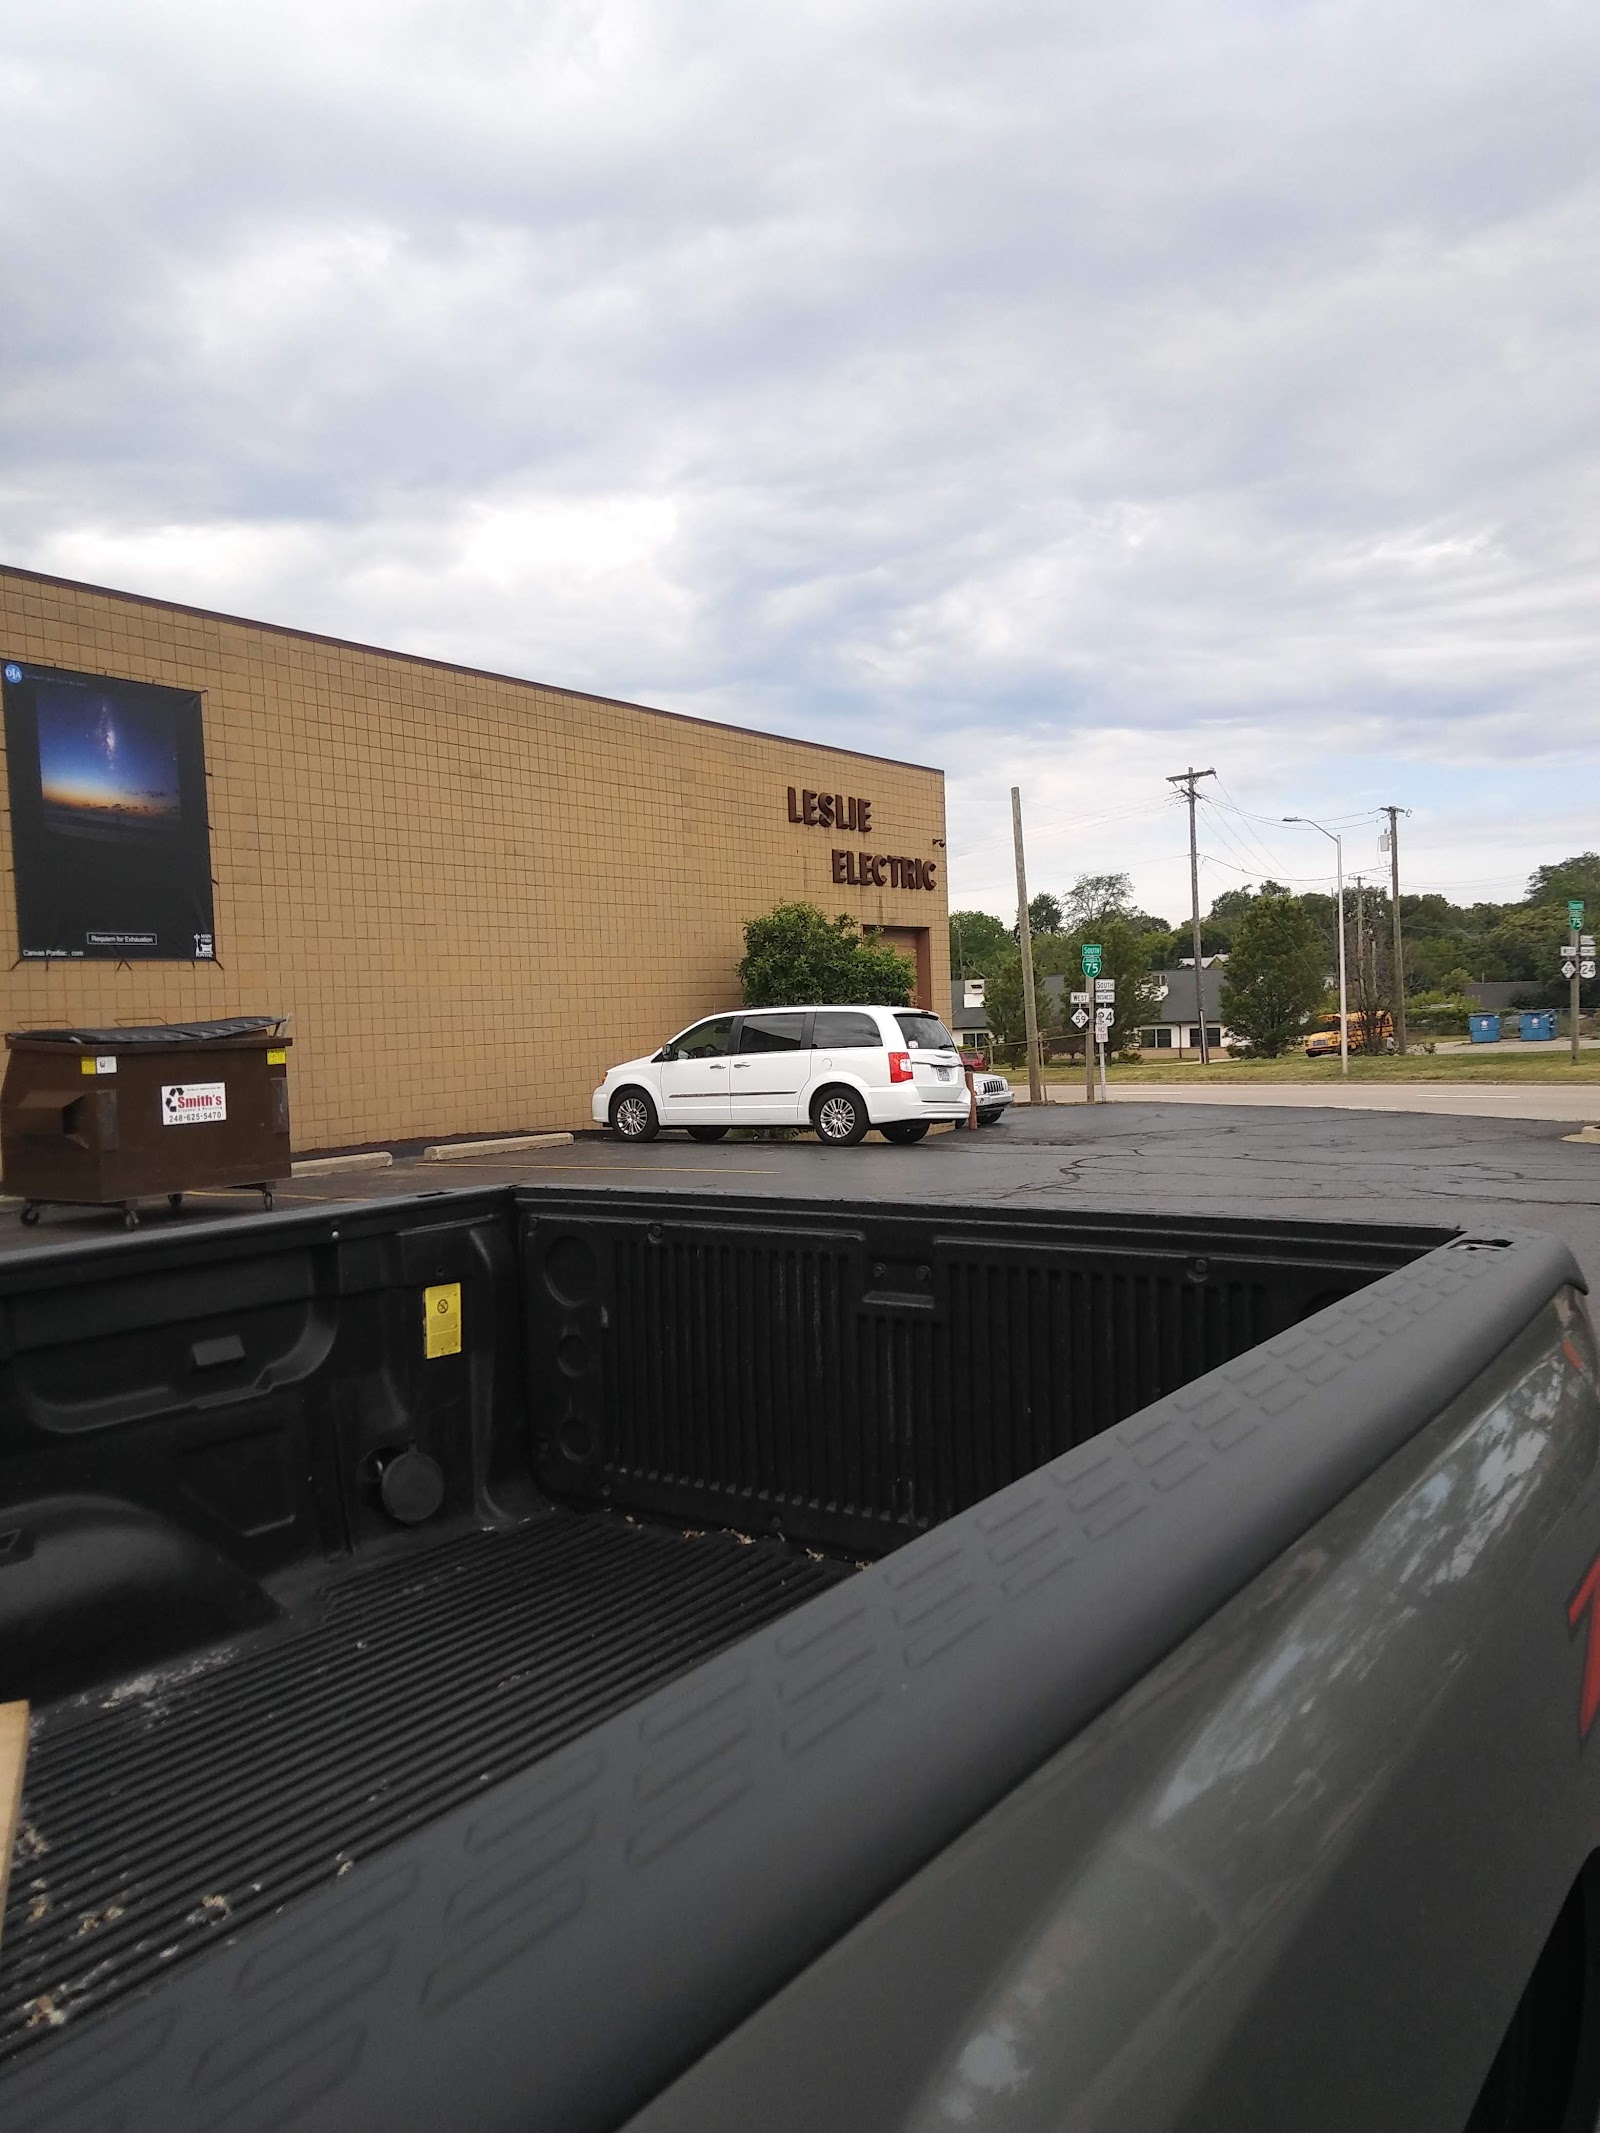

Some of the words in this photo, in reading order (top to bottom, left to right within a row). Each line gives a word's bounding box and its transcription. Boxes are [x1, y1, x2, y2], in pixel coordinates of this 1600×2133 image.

[5, 667, 21, 681] DIA
[788, 787, 873, 832] LESLIE
[832, 849, 938, 891] ELECTRIC
[91, 935, 116, 943] Requiem
[1085, 963, 1099, 974] 75
[1582, 965, 1595, 975] 24
[1096, 981, 1114, 989] SOUTH
[1073, 994, 1088, 1002] WEST
[1075, 1016, 1086, 1024] 59
[177, 1094, 222, 1109] Smith's
[169, 1111, 222, 1123] 248-625-5470
